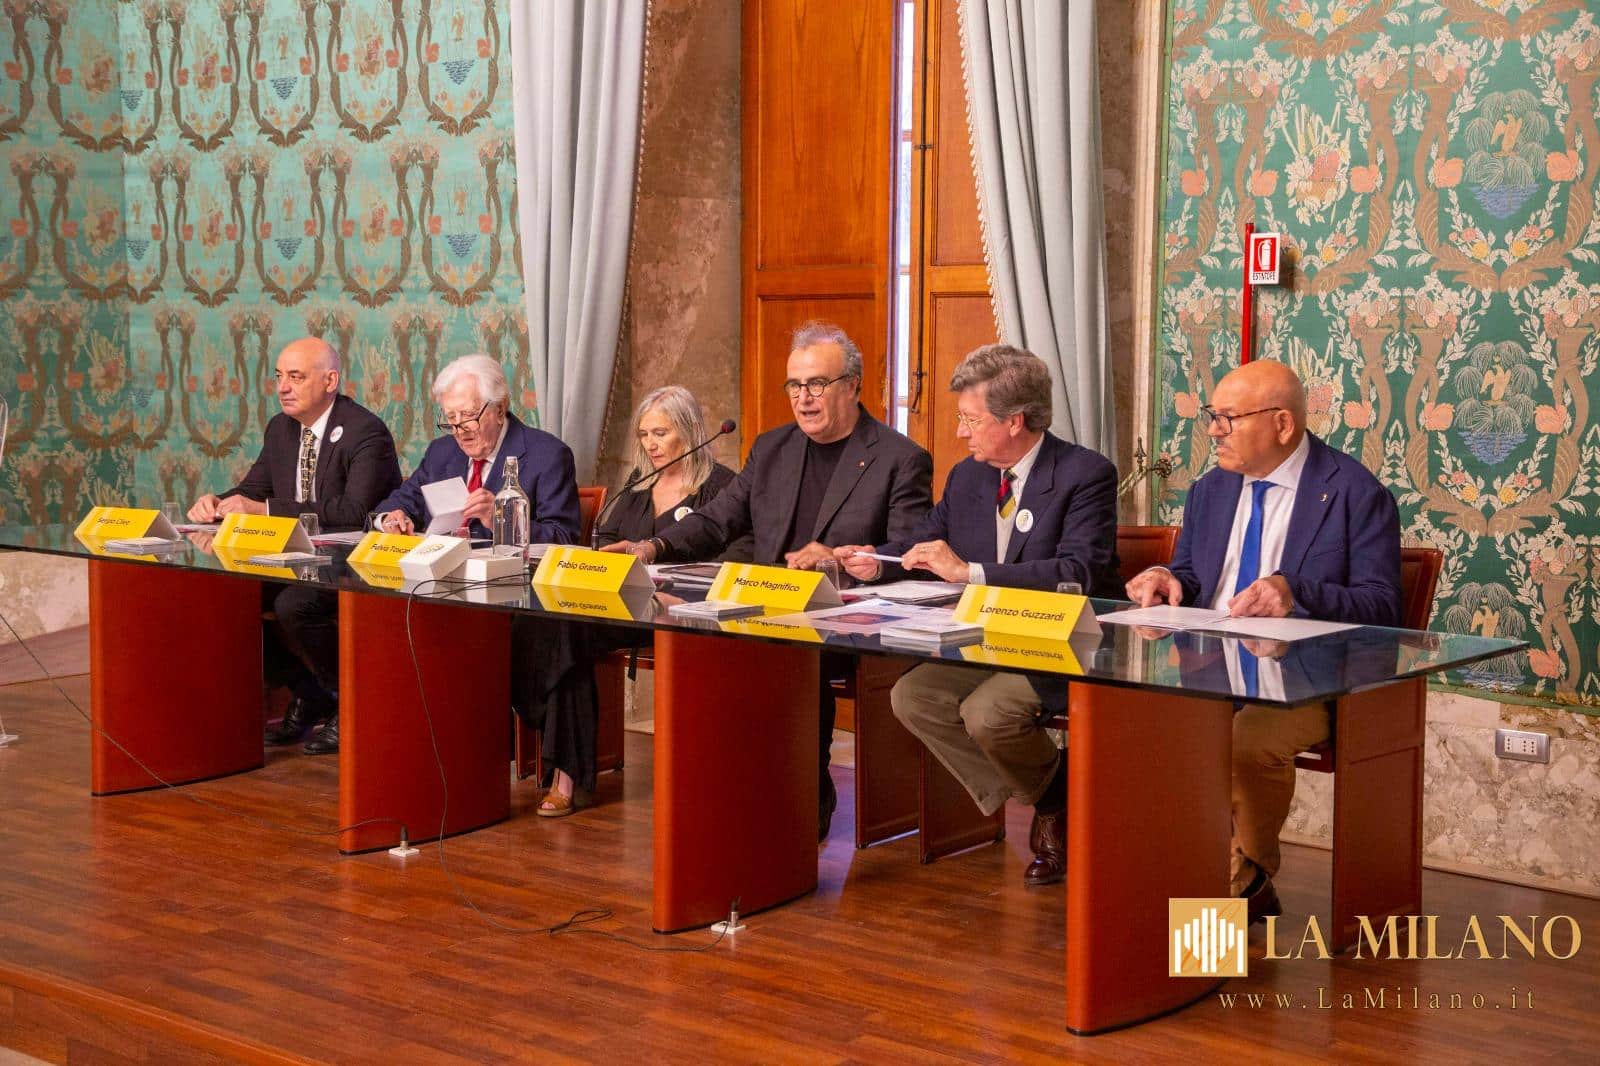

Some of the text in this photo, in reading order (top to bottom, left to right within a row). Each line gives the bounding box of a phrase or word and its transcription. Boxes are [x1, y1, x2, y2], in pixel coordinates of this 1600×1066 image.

[390, 545, 411, 554] Toscan
[557, 560, 608, 573] Fabio Granata
[733, 577, 800, 592] Marco Magnifico
[979, 604, 1066, 622] Lorenzo Guzzardi
